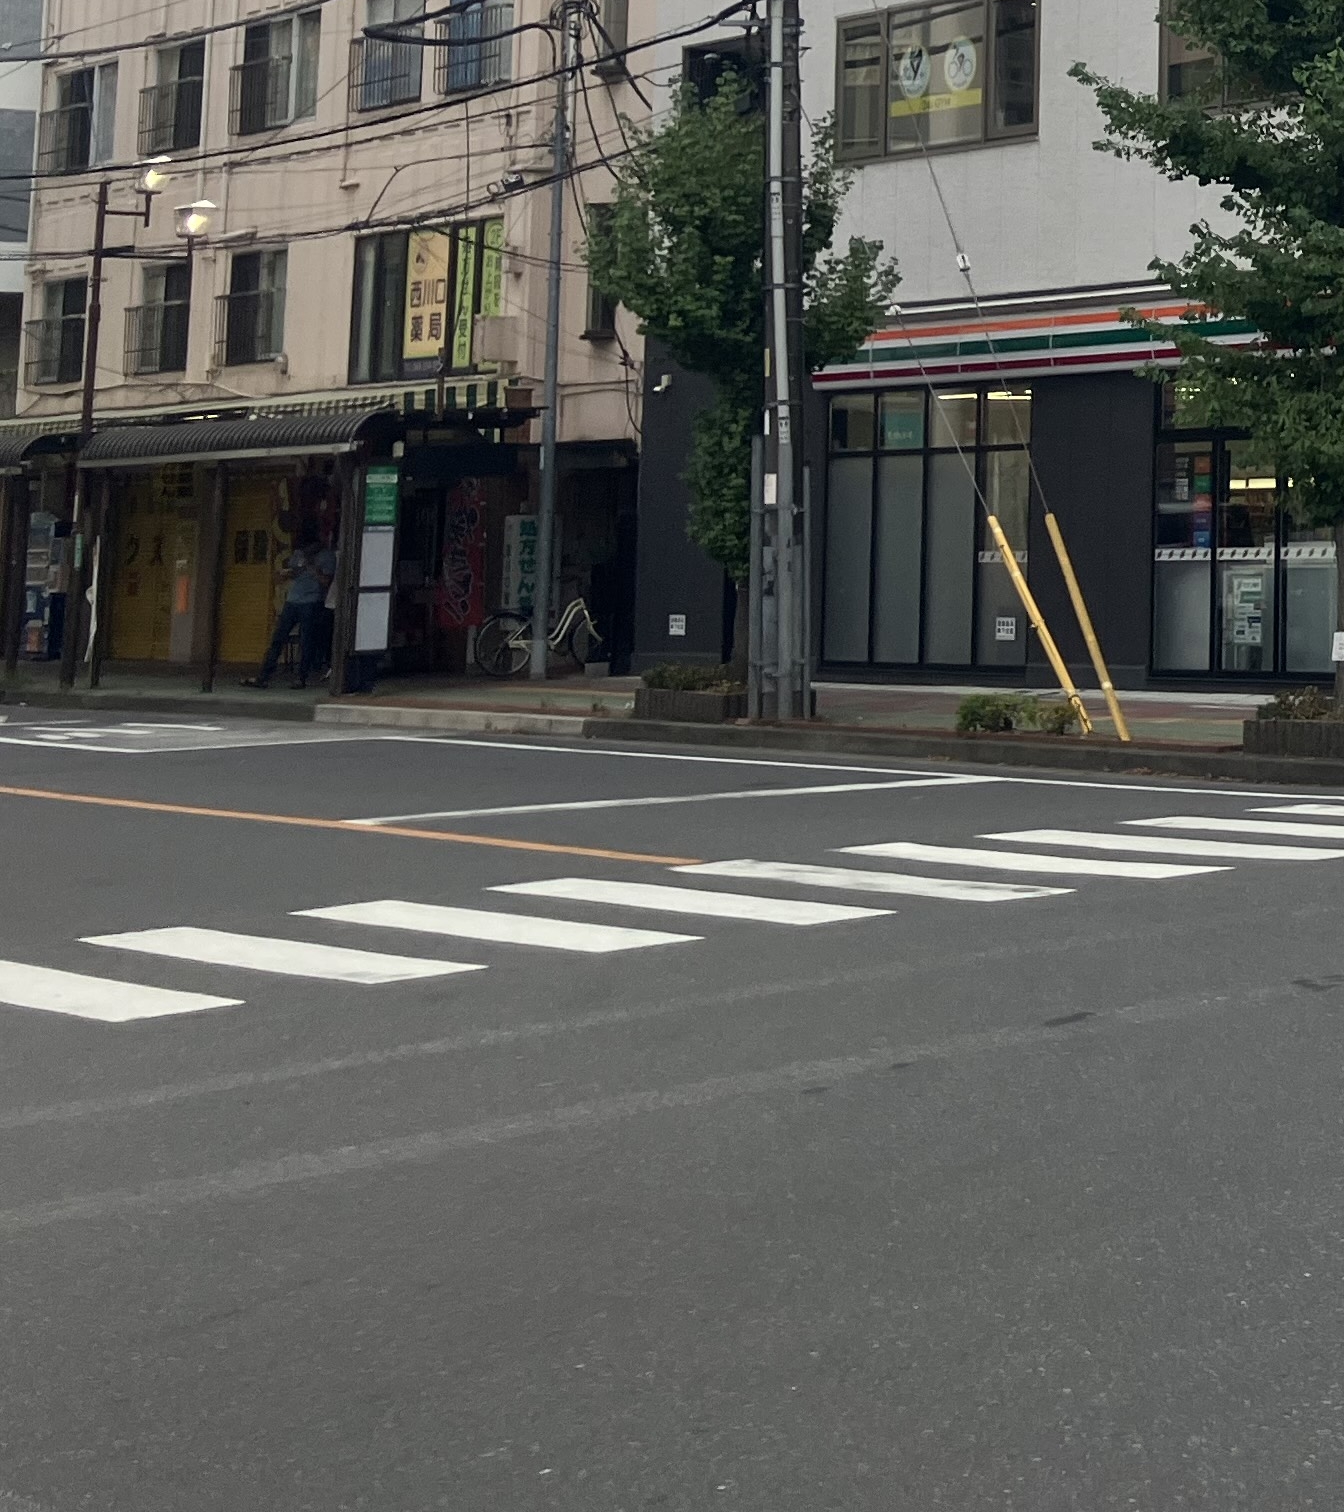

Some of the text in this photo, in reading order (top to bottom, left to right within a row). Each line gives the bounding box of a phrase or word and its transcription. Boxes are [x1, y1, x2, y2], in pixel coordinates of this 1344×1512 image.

[410, 278, 446, 308] 西川口
[411, 312, 442, 342] 薬局
